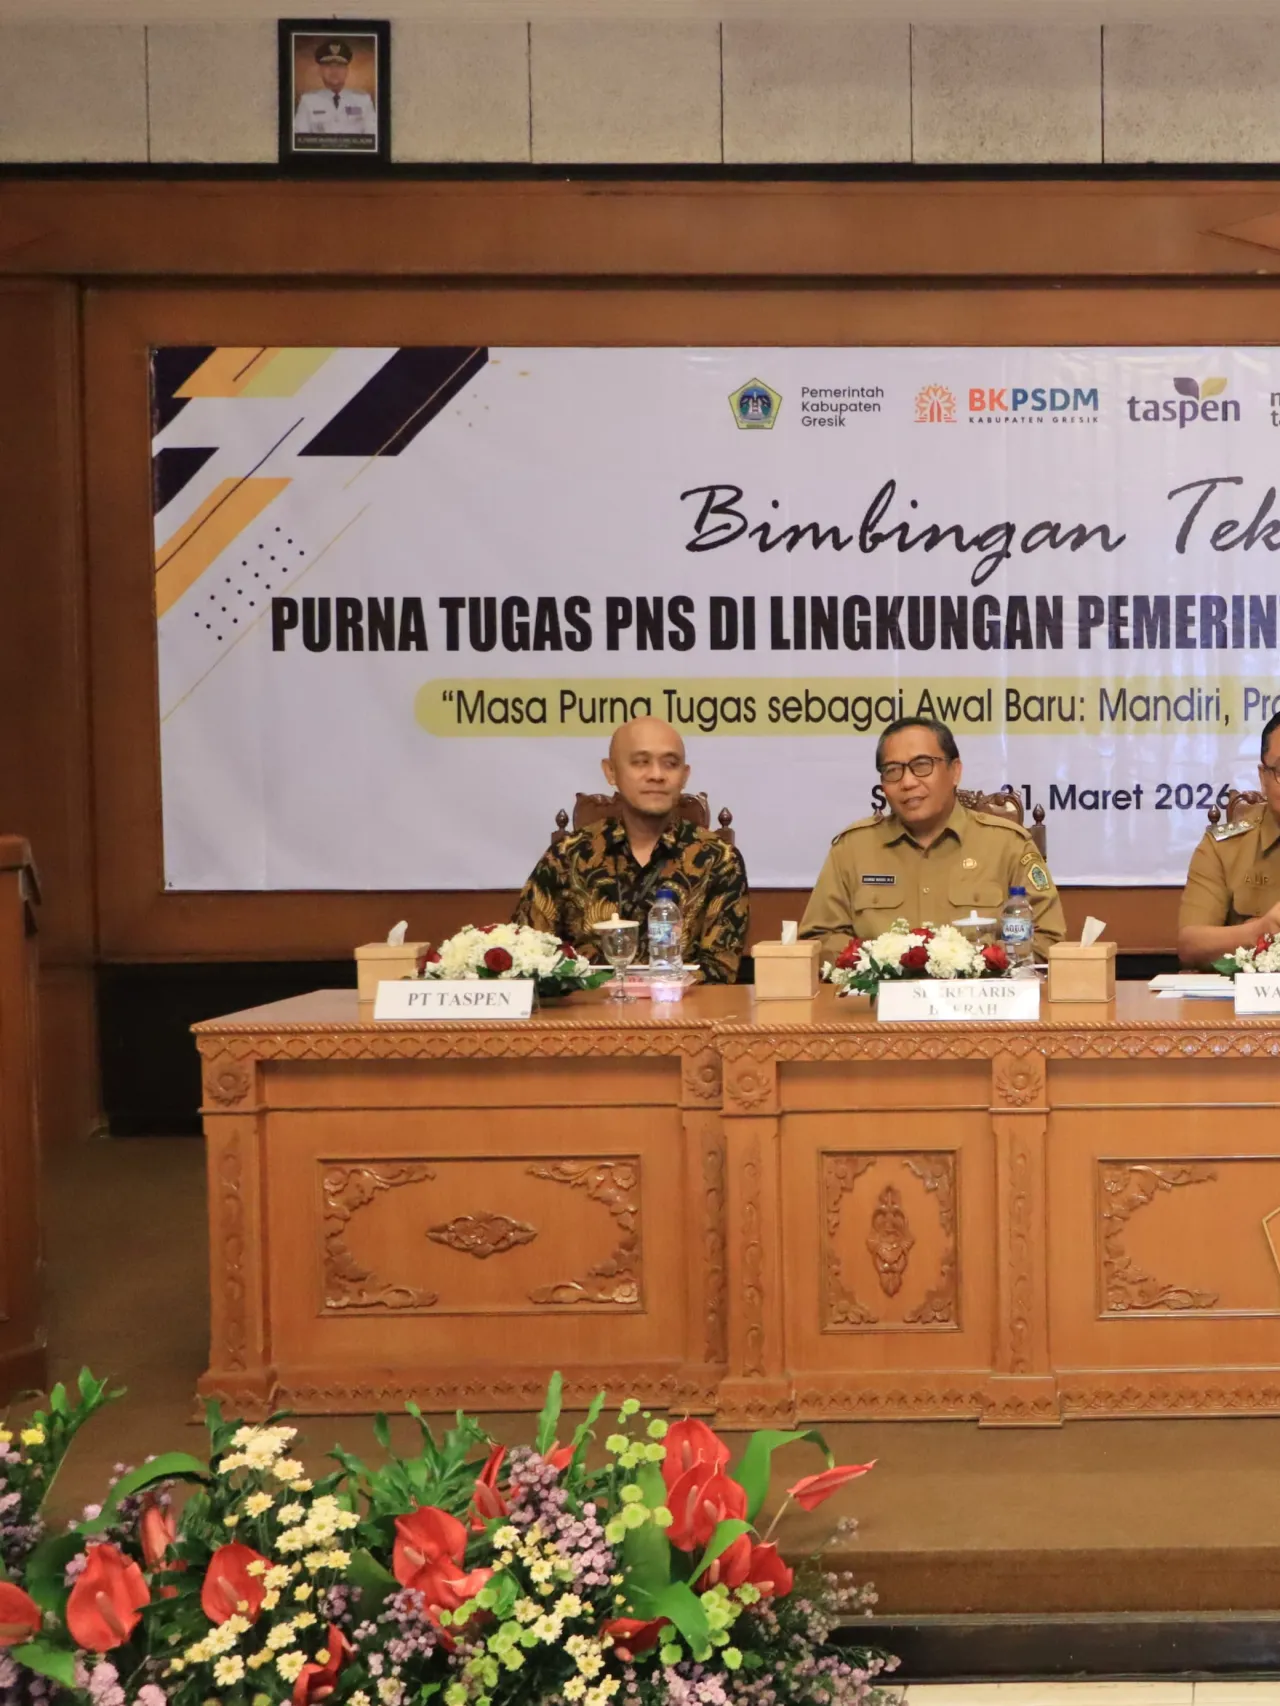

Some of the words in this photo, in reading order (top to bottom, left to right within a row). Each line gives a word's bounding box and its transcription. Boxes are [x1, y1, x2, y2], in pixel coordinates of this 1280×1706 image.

[801, 386, 885, 398] Pemerintah
[968, 388, 1099, 412] BKPSDM
[801, 400, 881, 416] Kabupaten
[968, 416, 1044, 424] KABUPATEN
[1052, 416, 1099, 424] GRESIK
[1126, 396, 1241, 429] taspen
[801, 415, 846, 427] Gresik
[680, 479, 1126, 587] Bimbingan
[271, 596, 429, 653] PURNA
[438, 595, 593, 653] TUGAS
[605, 595, 696, 652] PNS
[709, 595, 756, 651] DI
[770, 594, 1063, 651] LINGKUNGAN
[560, 689, 652, 724] Purna
[663, 689, 757, 733] Tugas
[768, 688, 904, 732] sebagai
[916, 688, 992, 723] Awal
[1005, 688, 1085, 722] Baru:
[1099, 687, 1230, 726] Mandiri,
[1048, 783, 1144, 810] Maret
[1154, 783, 1230, 810] 2026
[408, 992, 431, 1006] PT
[436, 992, 512, 1006] TASPEN
